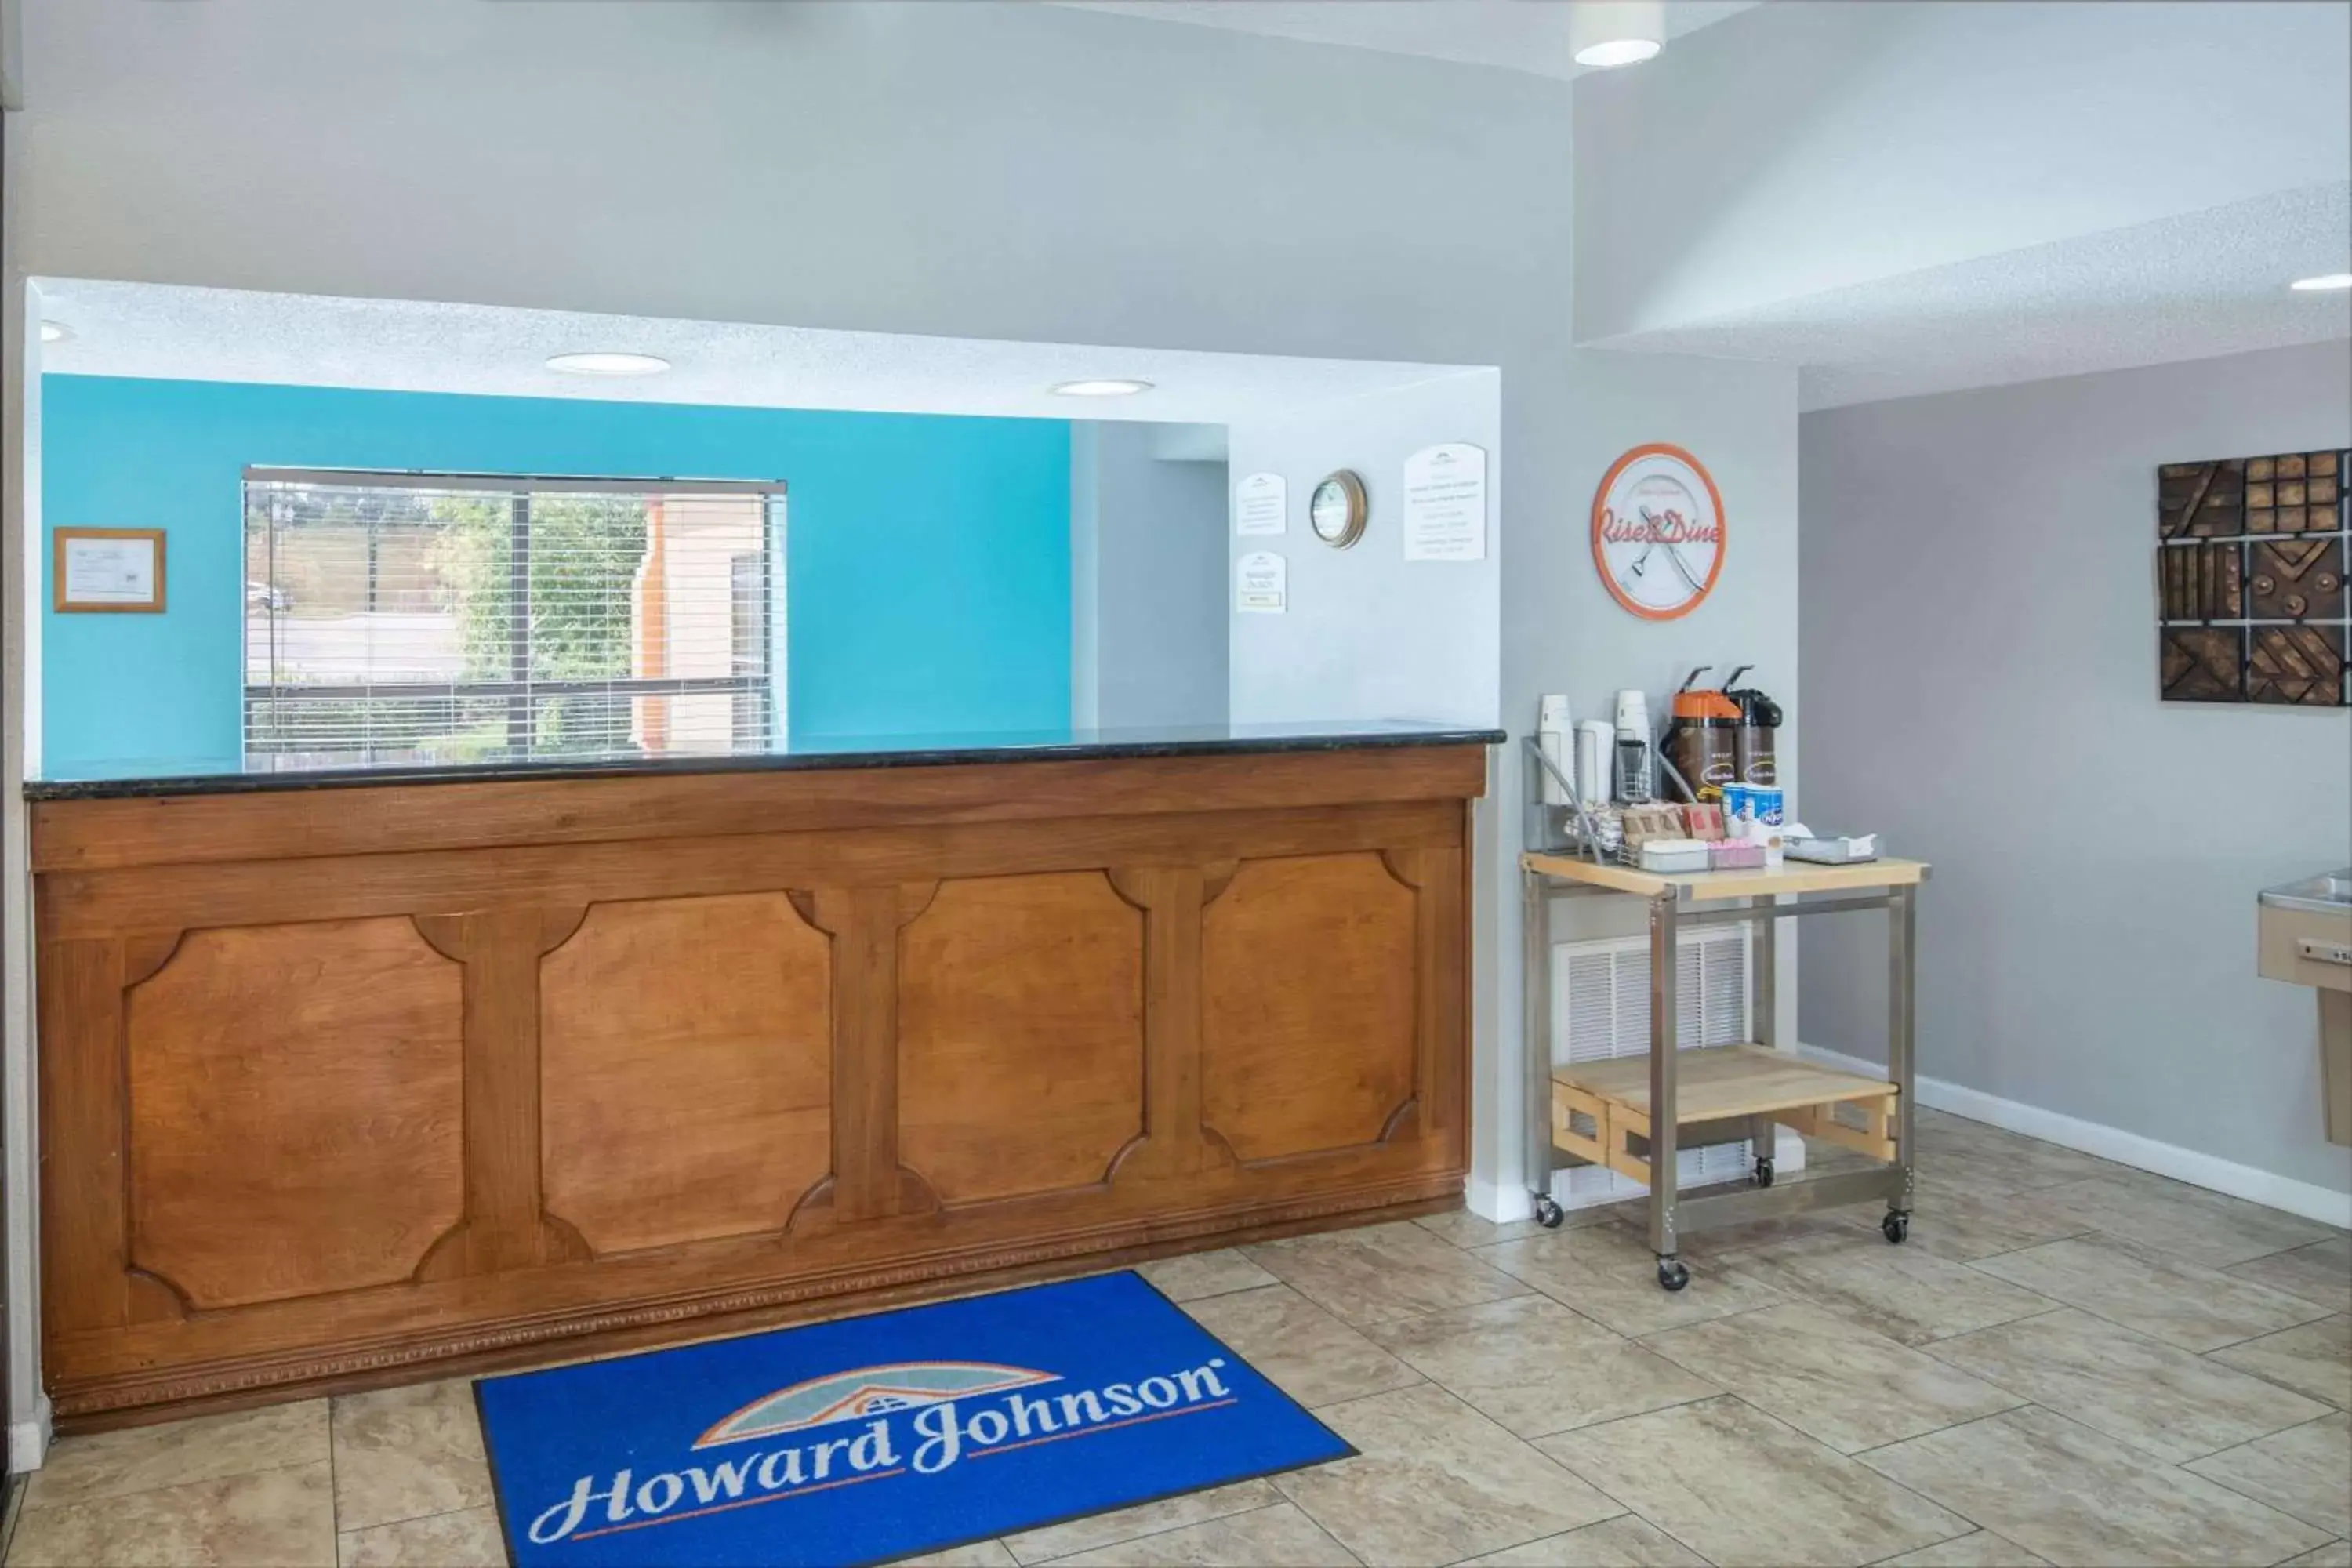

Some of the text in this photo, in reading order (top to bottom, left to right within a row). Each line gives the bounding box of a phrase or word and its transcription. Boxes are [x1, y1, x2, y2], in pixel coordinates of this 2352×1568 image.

[1602, 506, 1647, 544] Rise
[1659, 509, 1720, 544] Dine
[528, 1365, 1229, 1544] Howard Johnson
